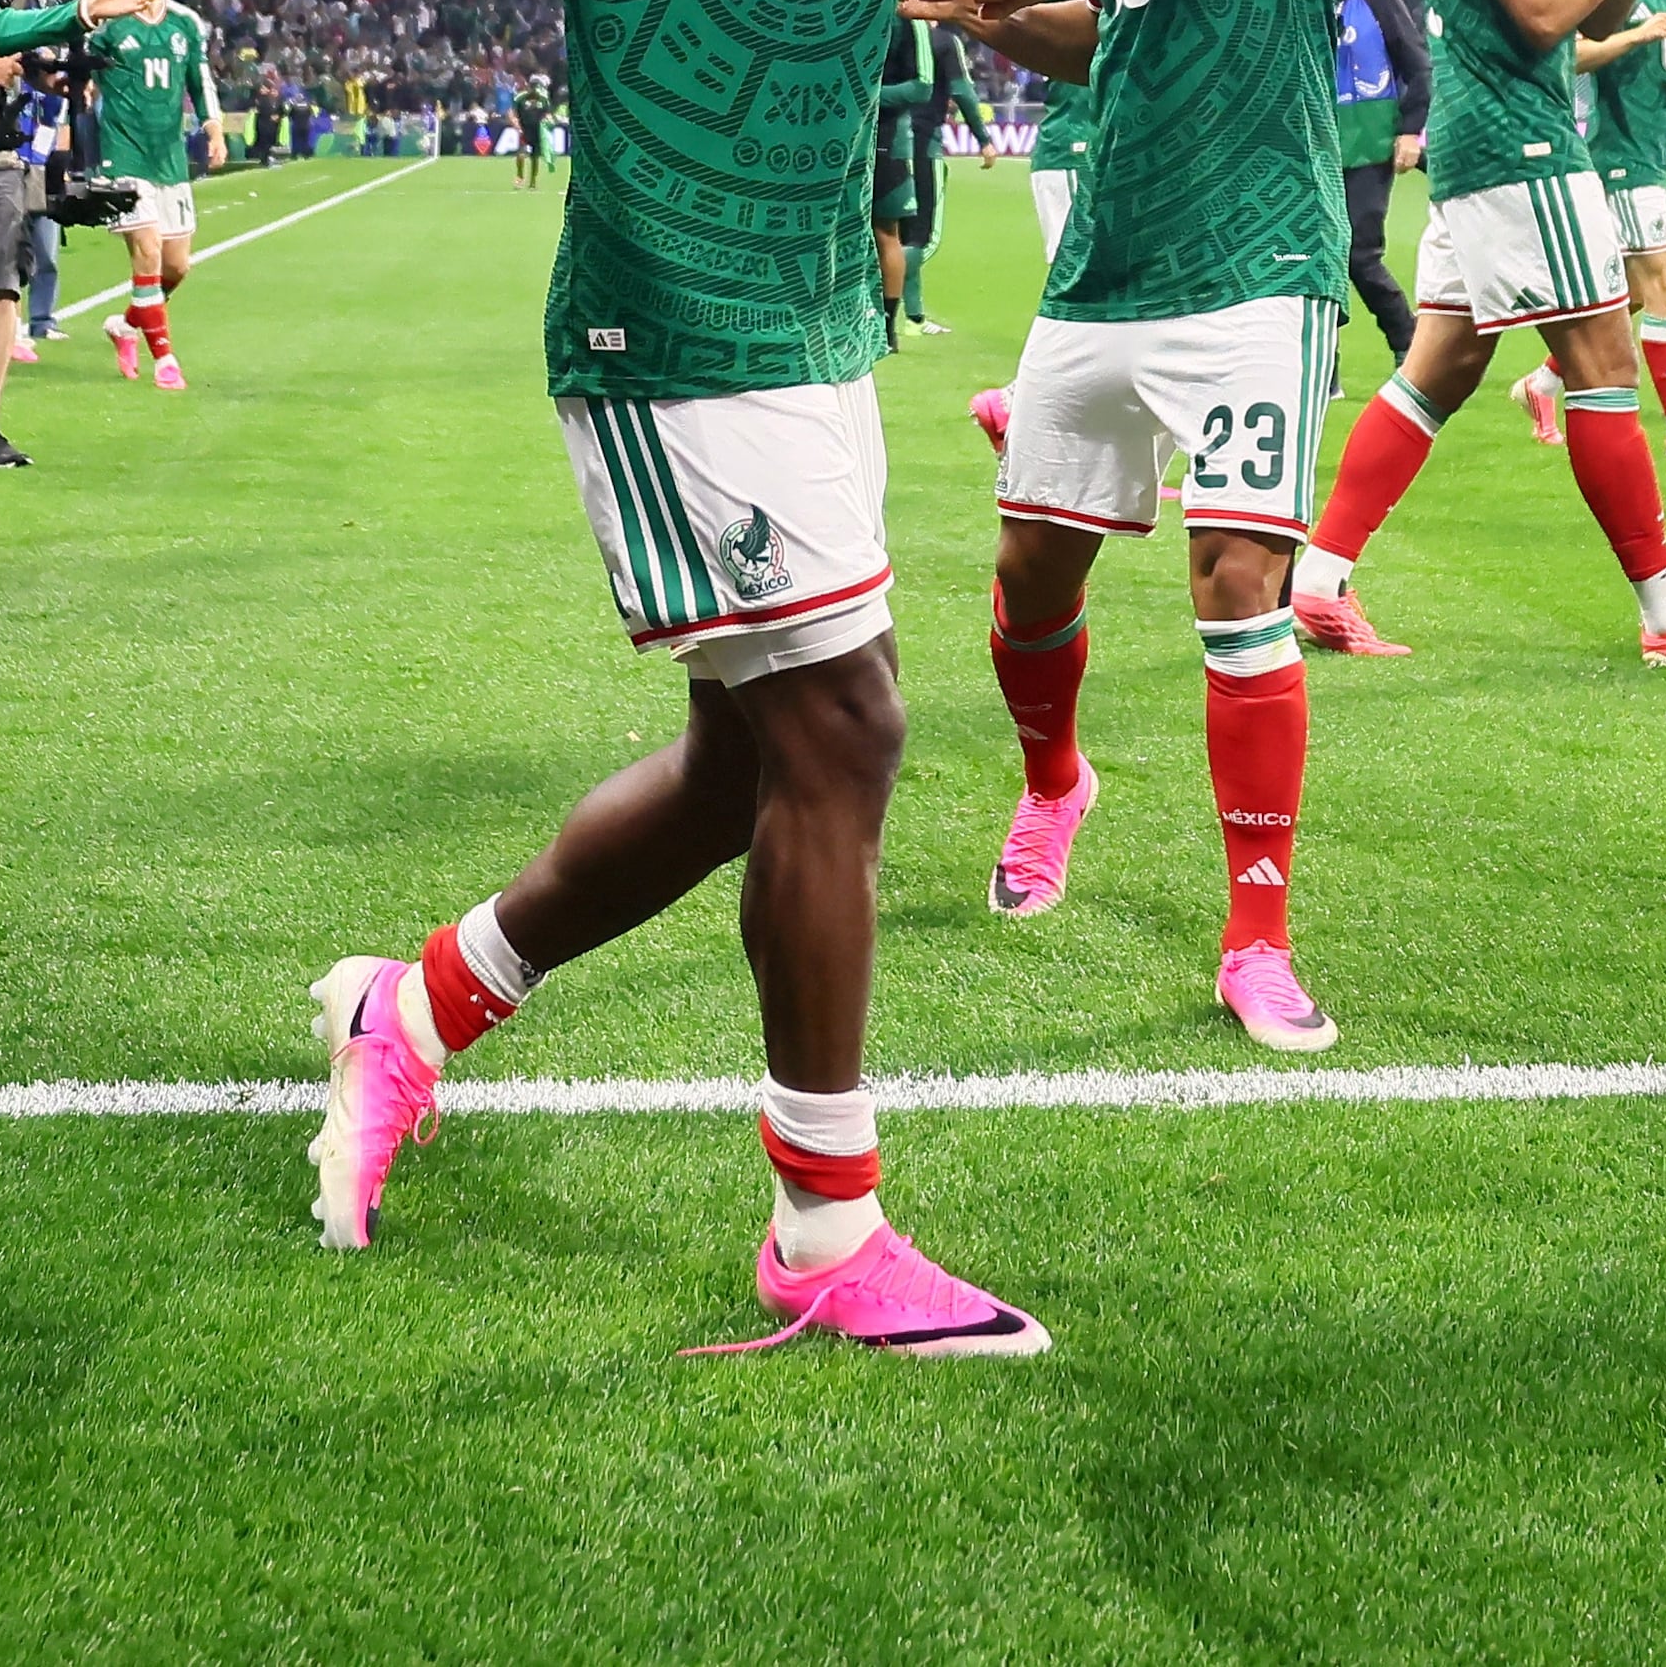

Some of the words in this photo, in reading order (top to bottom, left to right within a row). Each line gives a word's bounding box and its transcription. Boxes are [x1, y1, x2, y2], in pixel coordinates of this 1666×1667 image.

[143, 58, 171, 90] 14
[1194, 401, 1287, 490] 23
[1222, 808, 1292, 827] MÉXICO
